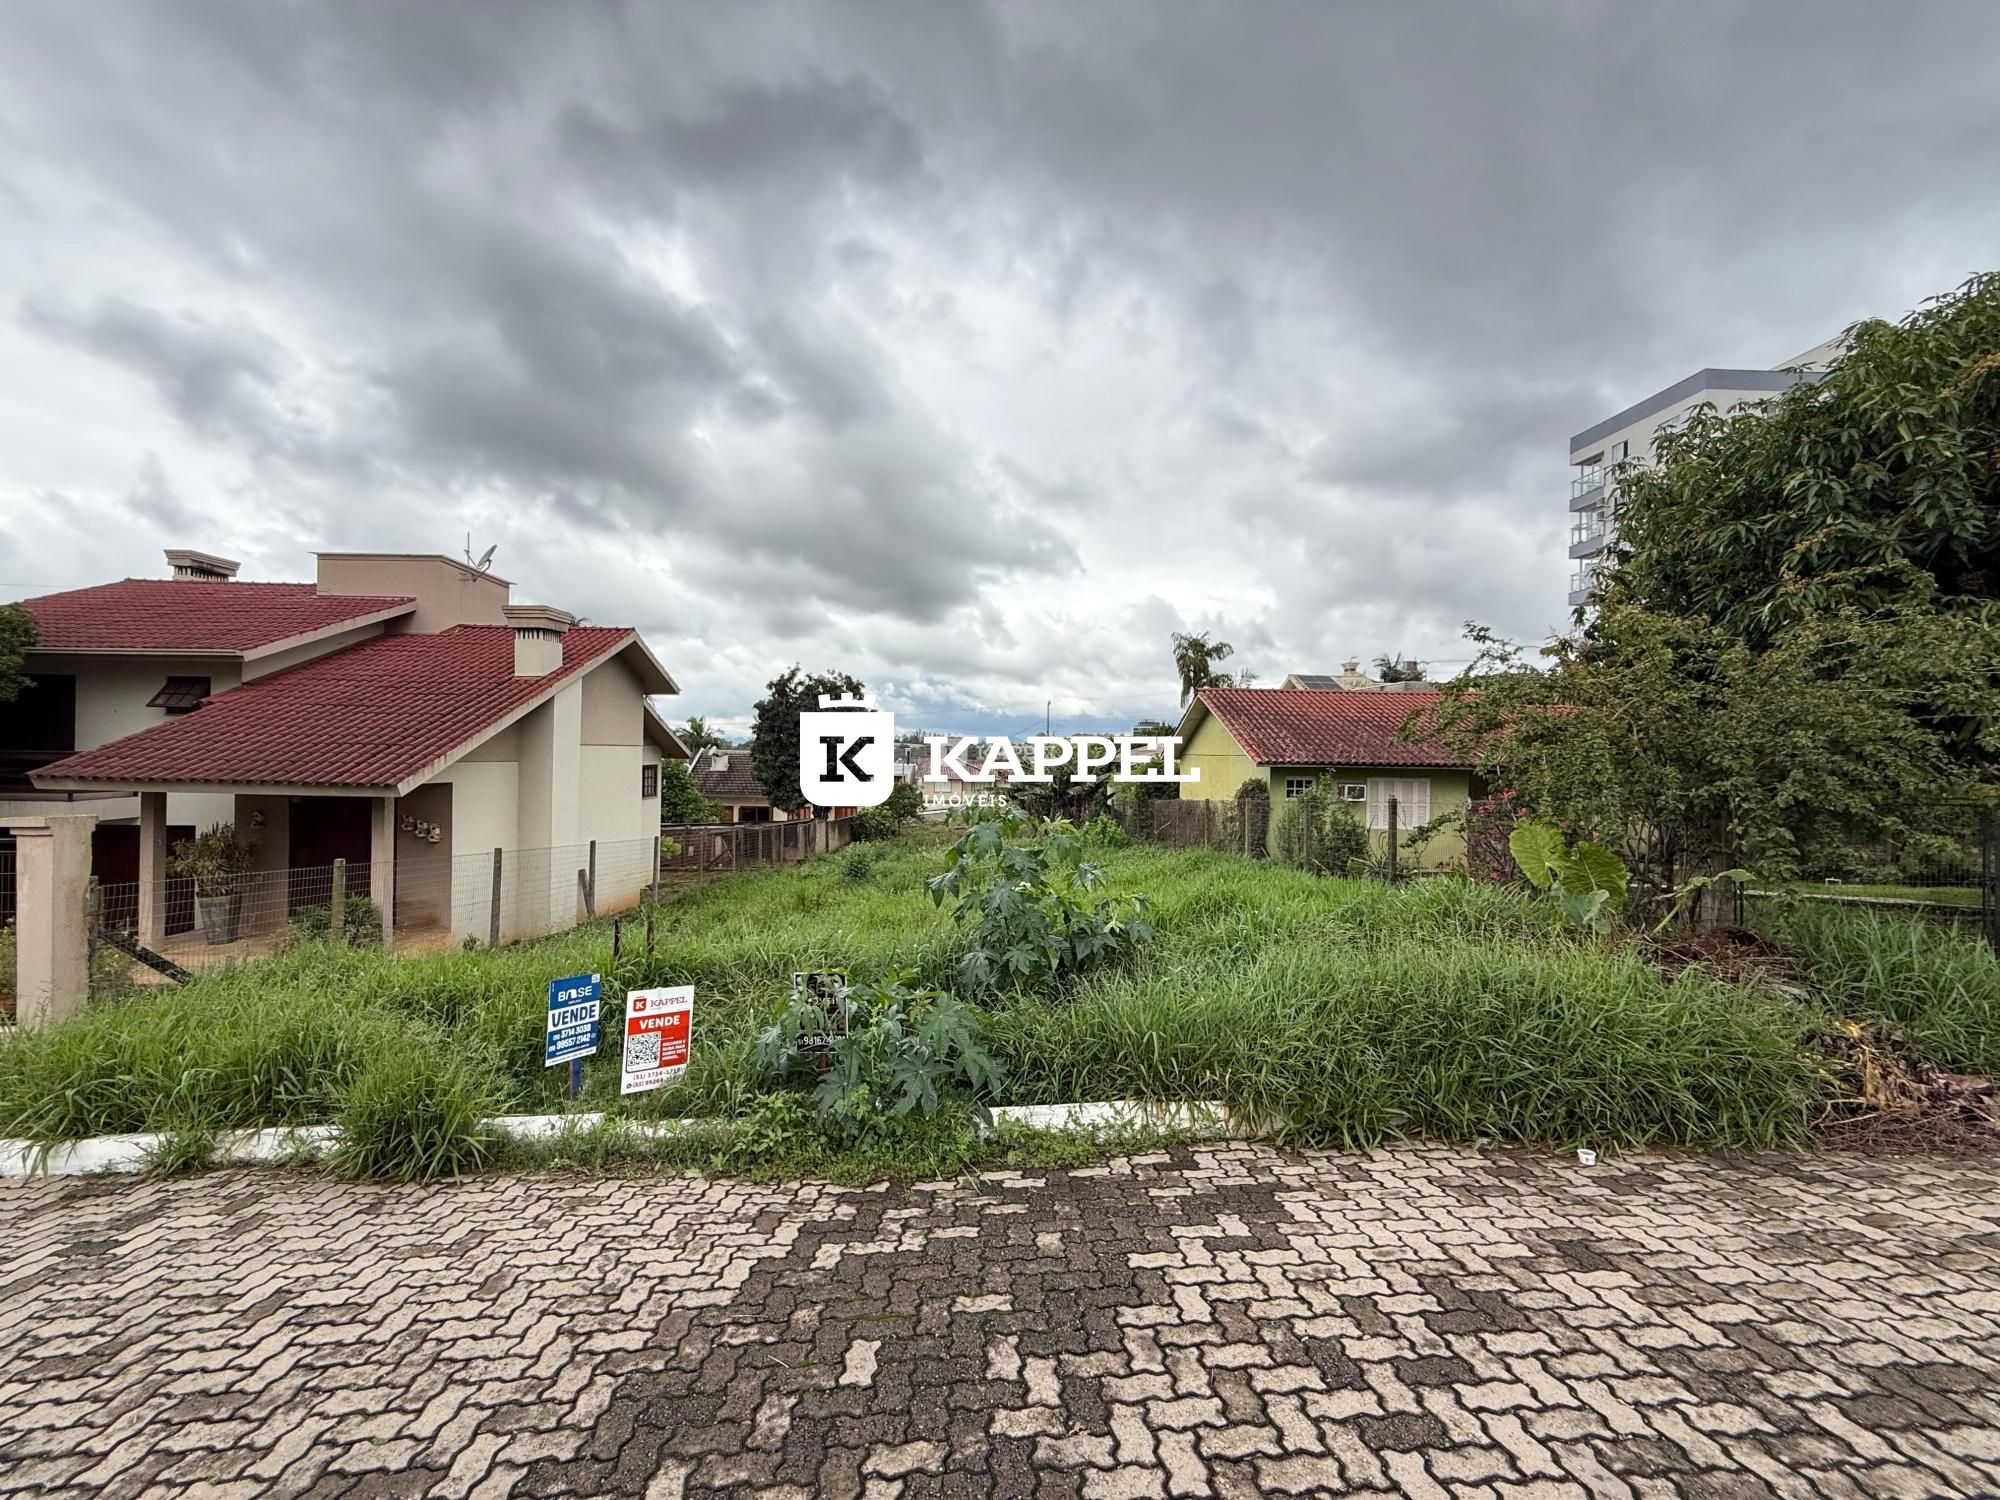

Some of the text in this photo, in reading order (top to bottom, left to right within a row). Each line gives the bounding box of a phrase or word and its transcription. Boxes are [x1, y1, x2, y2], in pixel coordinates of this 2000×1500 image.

[650, 997, 688, 1007] KAPPEL
[552, 1004, 596, 1027] VENDE
[640, 1015, 680, 1029] VENDE
